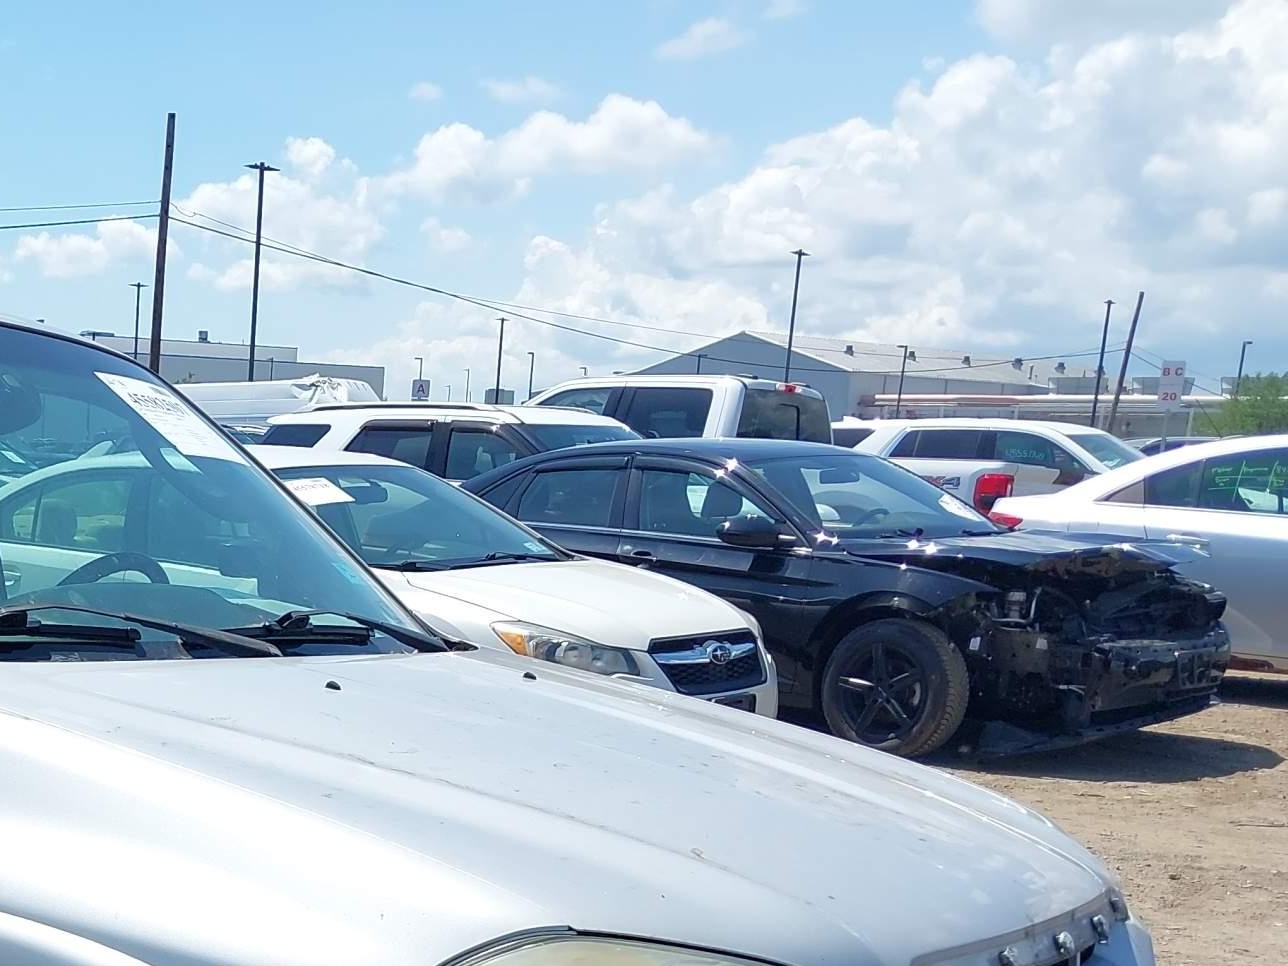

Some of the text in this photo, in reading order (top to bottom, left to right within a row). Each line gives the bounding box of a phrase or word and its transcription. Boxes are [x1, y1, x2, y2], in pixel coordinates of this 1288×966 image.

[1162, 367, 1184, 377] B C
[416, 383, 426, 395] A
[1161, 392, 1177, 401] 20
